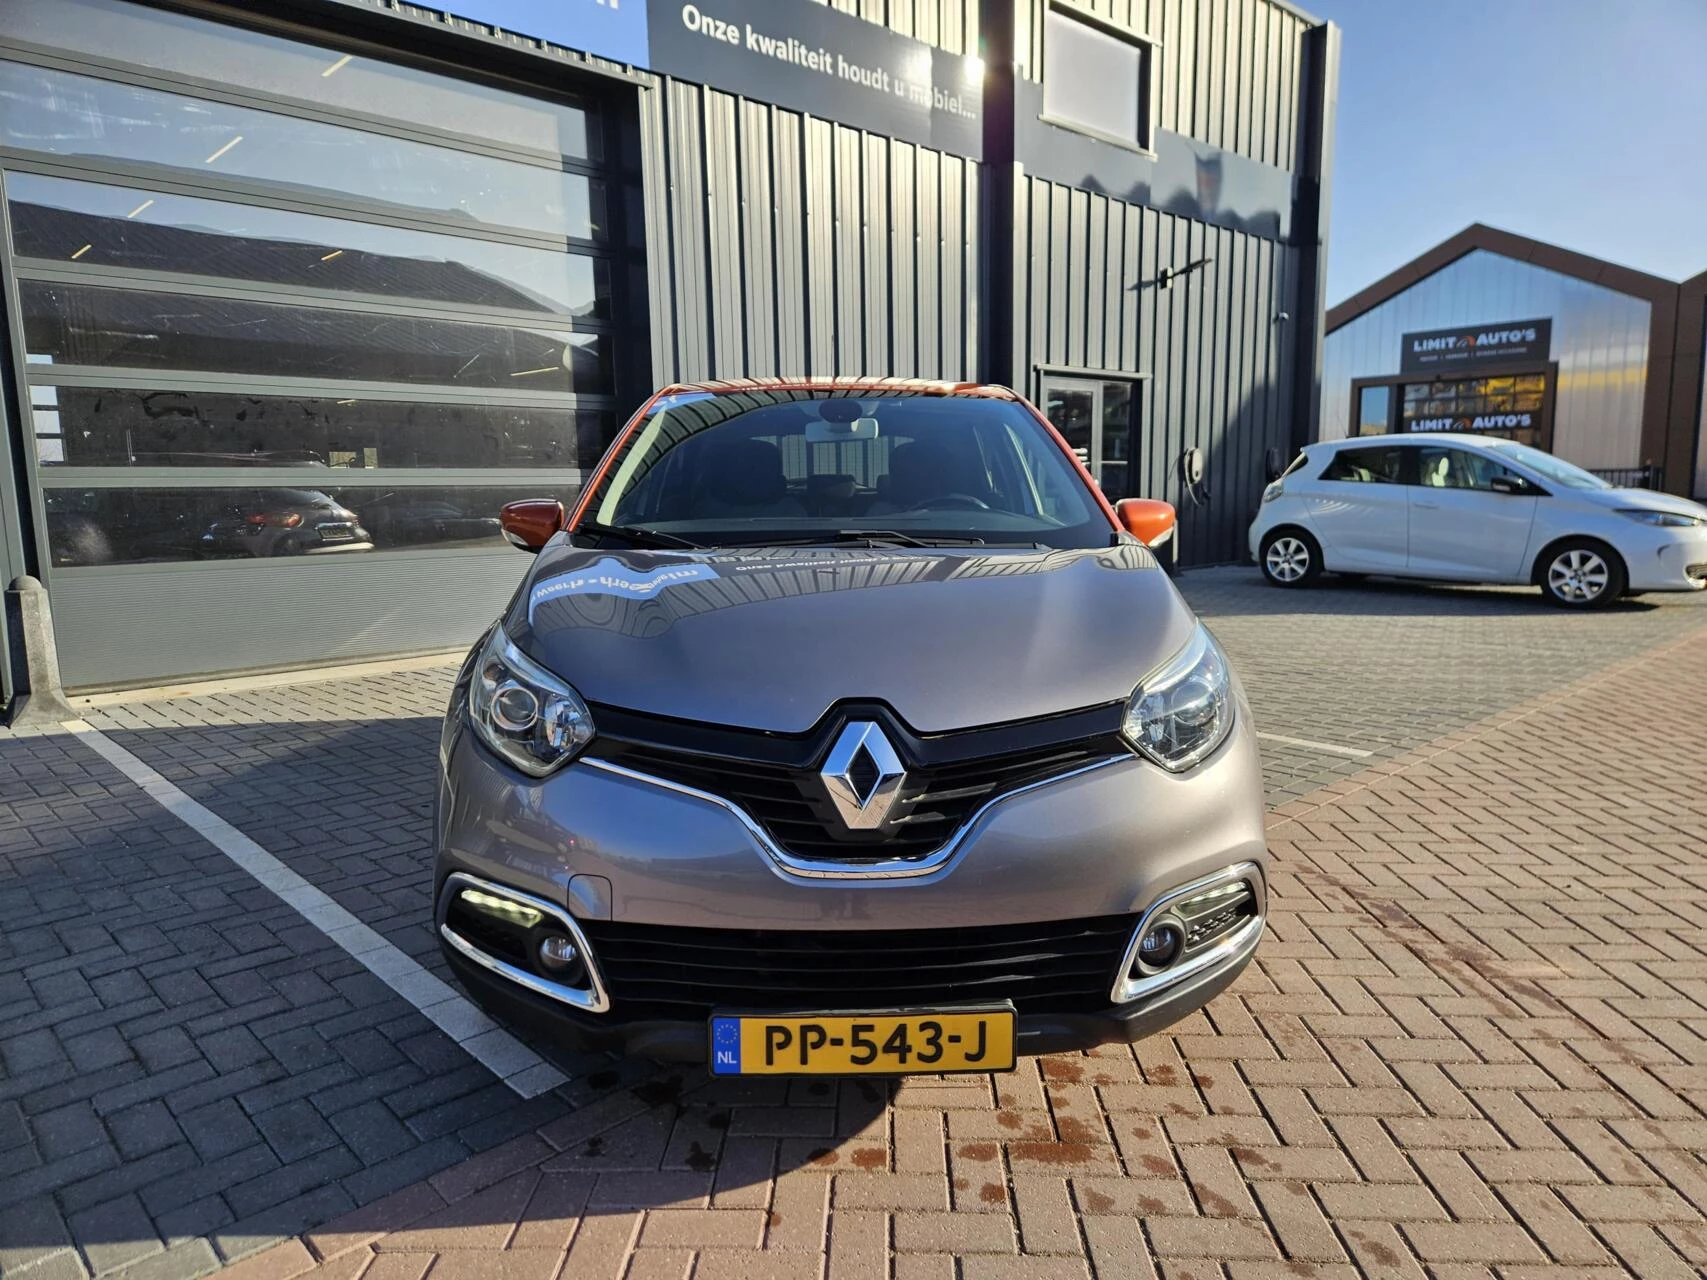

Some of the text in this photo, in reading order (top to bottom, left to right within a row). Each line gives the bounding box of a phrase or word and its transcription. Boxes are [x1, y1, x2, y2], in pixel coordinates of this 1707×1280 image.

[682, 4, 740, 45] Onze
[746, 24, 833, 74] kwaliteit
[838, 59, 890, 93] houdt
[894, 79, 904, 97] u
[1413, 328, 1536, 352] LIMIT AUTO'S
[1411, 414, 1531, 431] LIMIT AUTO'S
[765, 1020, 987, 1066] PP-543-J
[717, 1051, 737, 1064] NL
